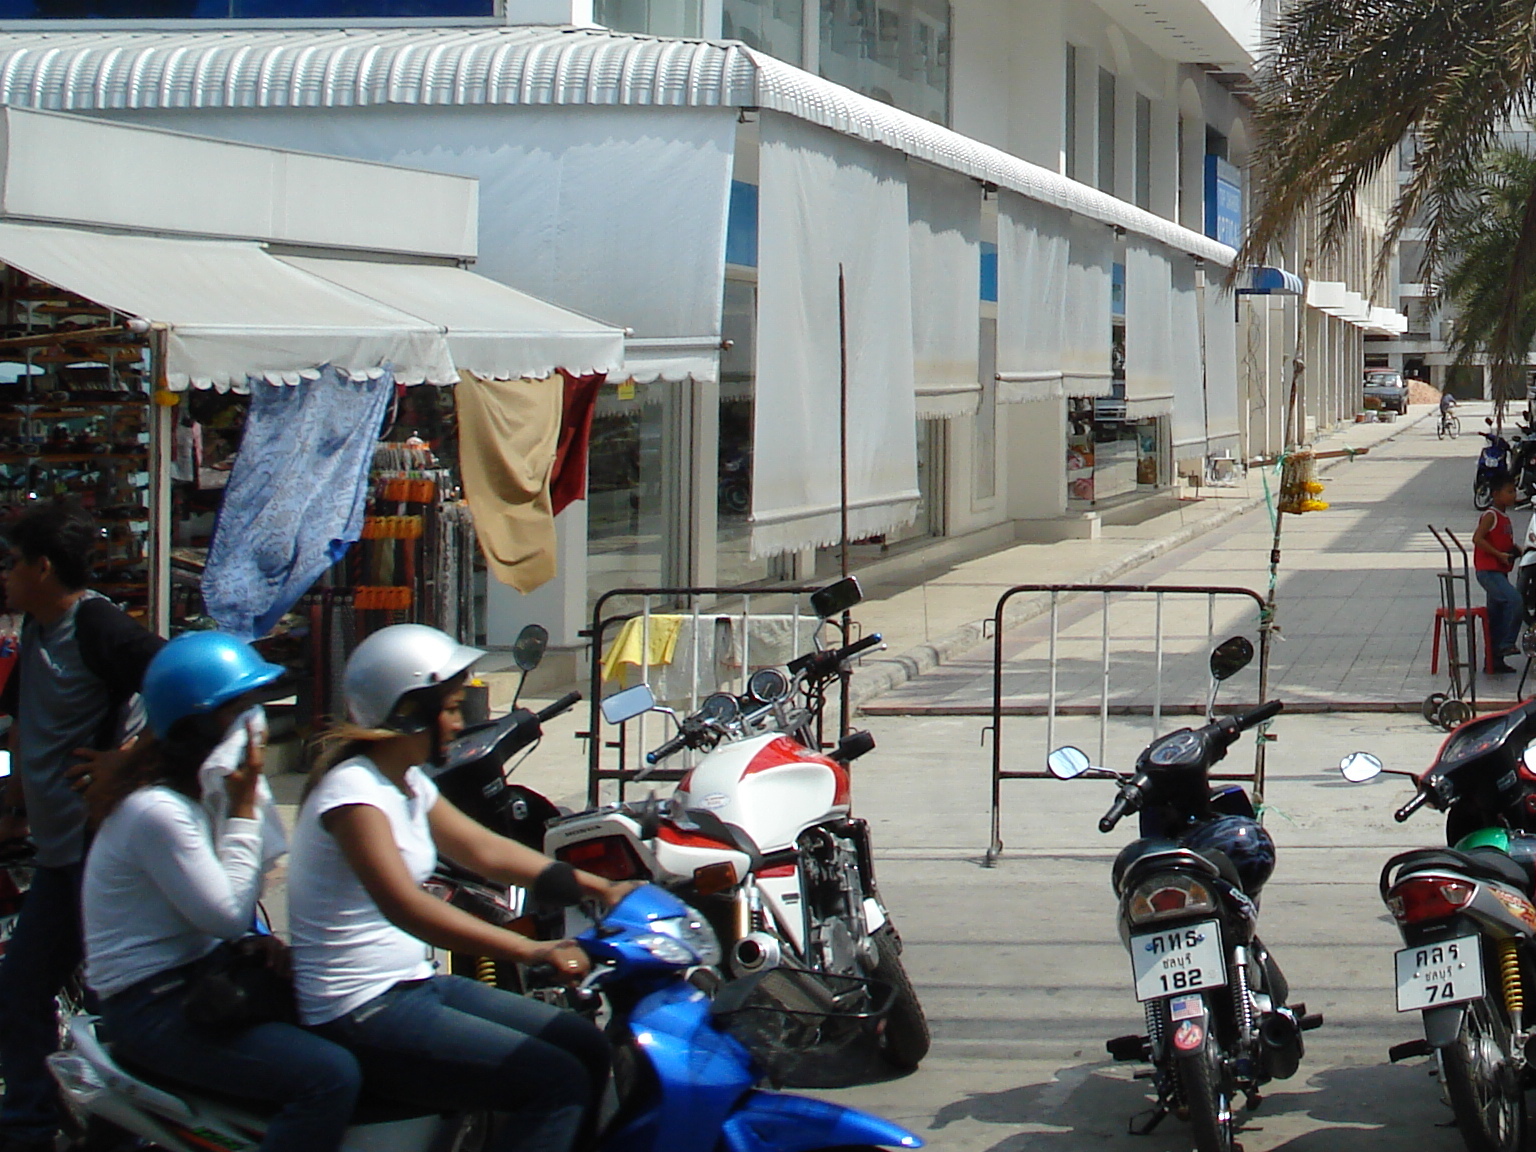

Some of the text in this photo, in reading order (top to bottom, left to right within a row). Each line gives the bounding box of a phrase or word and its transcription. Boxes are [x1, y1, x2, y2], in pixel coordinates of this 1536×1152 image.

[1163, 952, 1192, 969] ชลบุรี
[1160, 968, 1202, 992] 182
[1425, 982, 1454, 1003] 74
